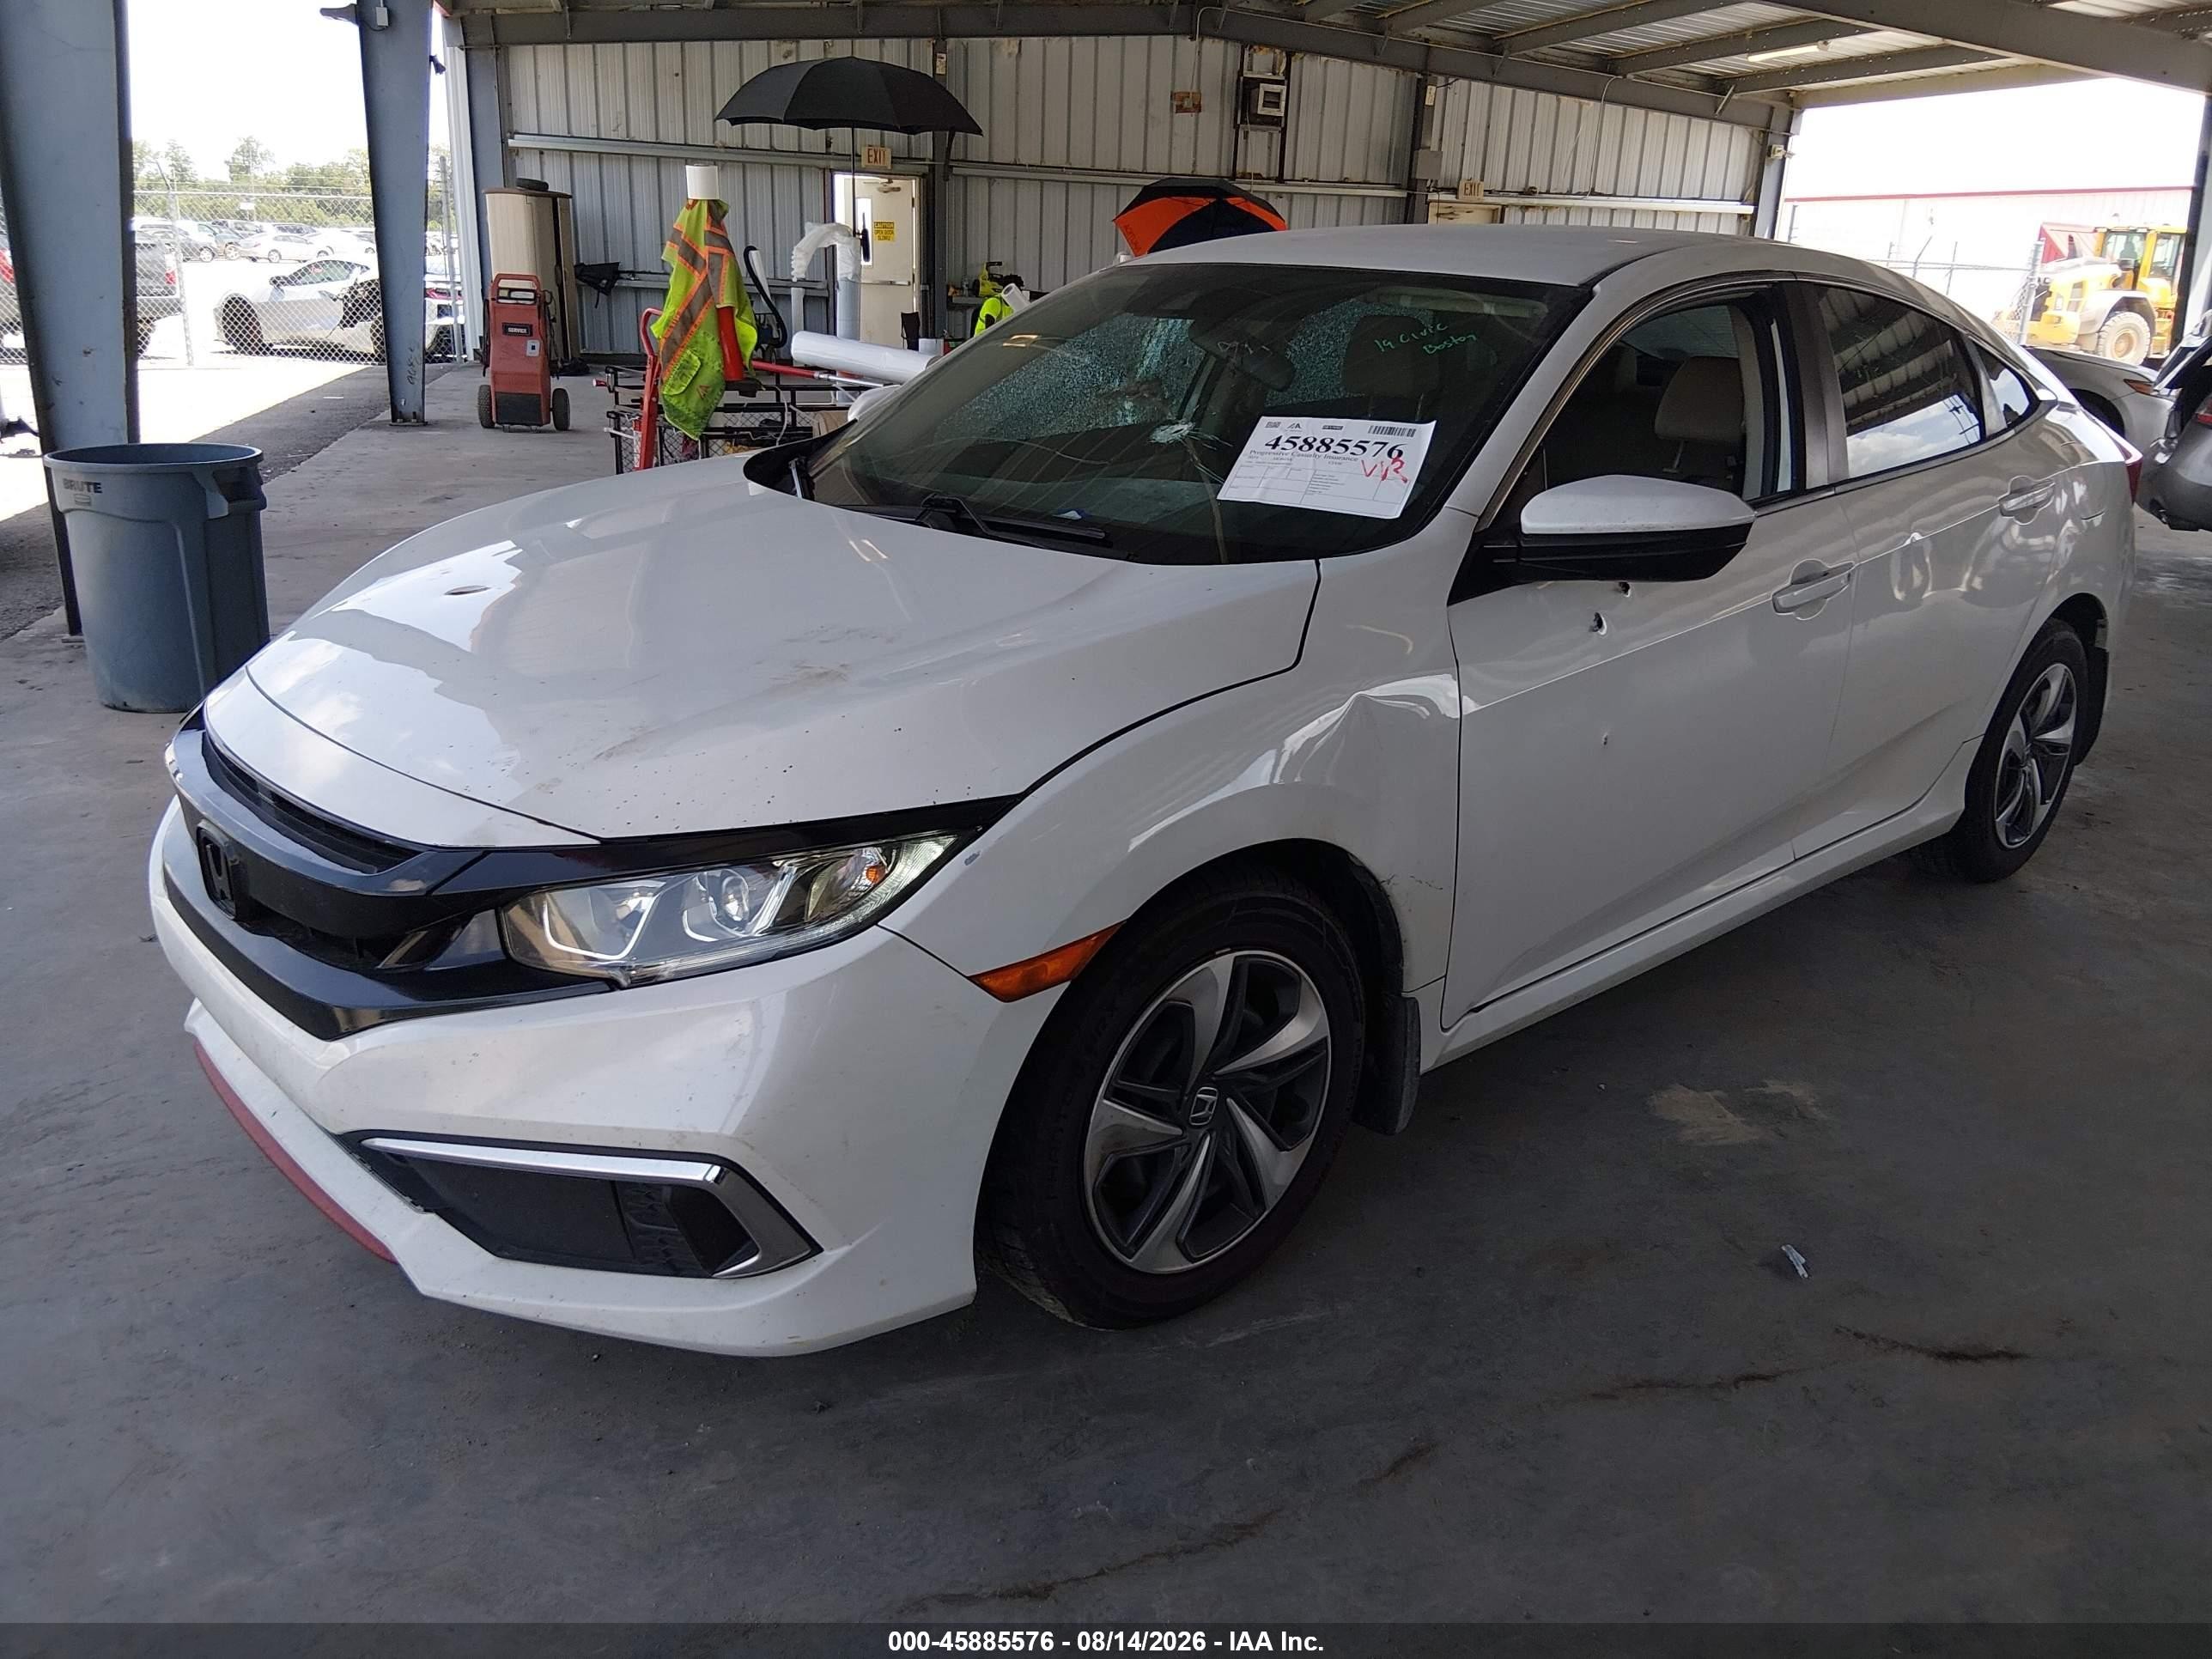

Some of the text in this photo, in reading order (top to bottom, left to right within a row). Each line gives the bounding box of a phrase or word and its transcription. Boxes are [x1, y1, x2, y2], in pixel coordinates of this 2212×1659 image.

[867, 148, 886, 165] EXIT
[1463, 182, 1480, 197] EXIT
[1249, 449, 1291, 458] Progressive
[1291, 451, 1322, 459] Casualty
[1323, 453, 1359, 462] Insurance
[1265, 434, 1409, 461] 45885576
[63, 478, 103, 494] BRUTE
